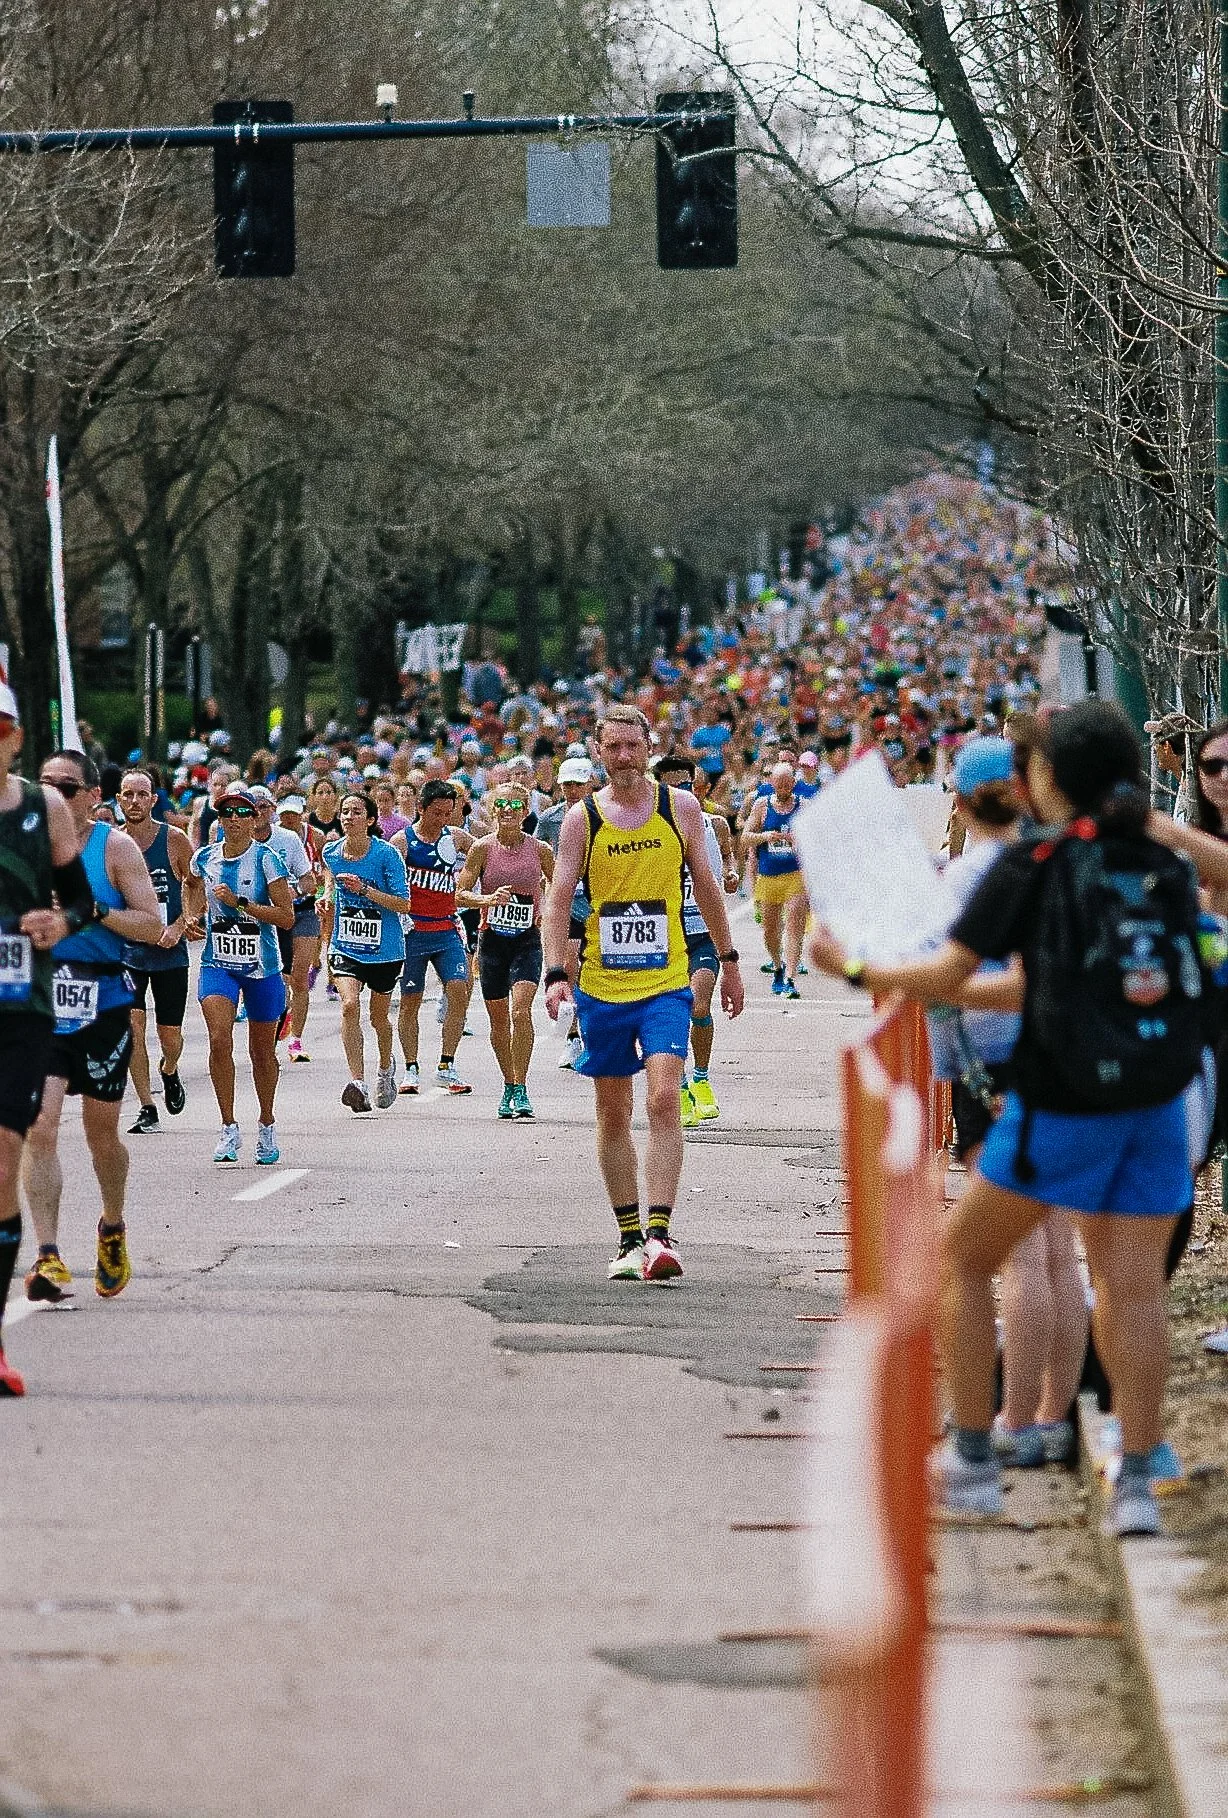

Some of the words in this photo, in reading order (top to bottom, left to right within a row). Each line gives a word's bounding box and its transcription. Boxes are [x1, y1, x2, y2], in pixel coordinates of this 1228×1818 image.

[607, 837, 662, 857] Metros
[343, 919, 377, 938] 14040
[612, 919, 656, 944] 8783
[216, 935, 256, 956] 15185
[56, 983, 91, 1009] 054
